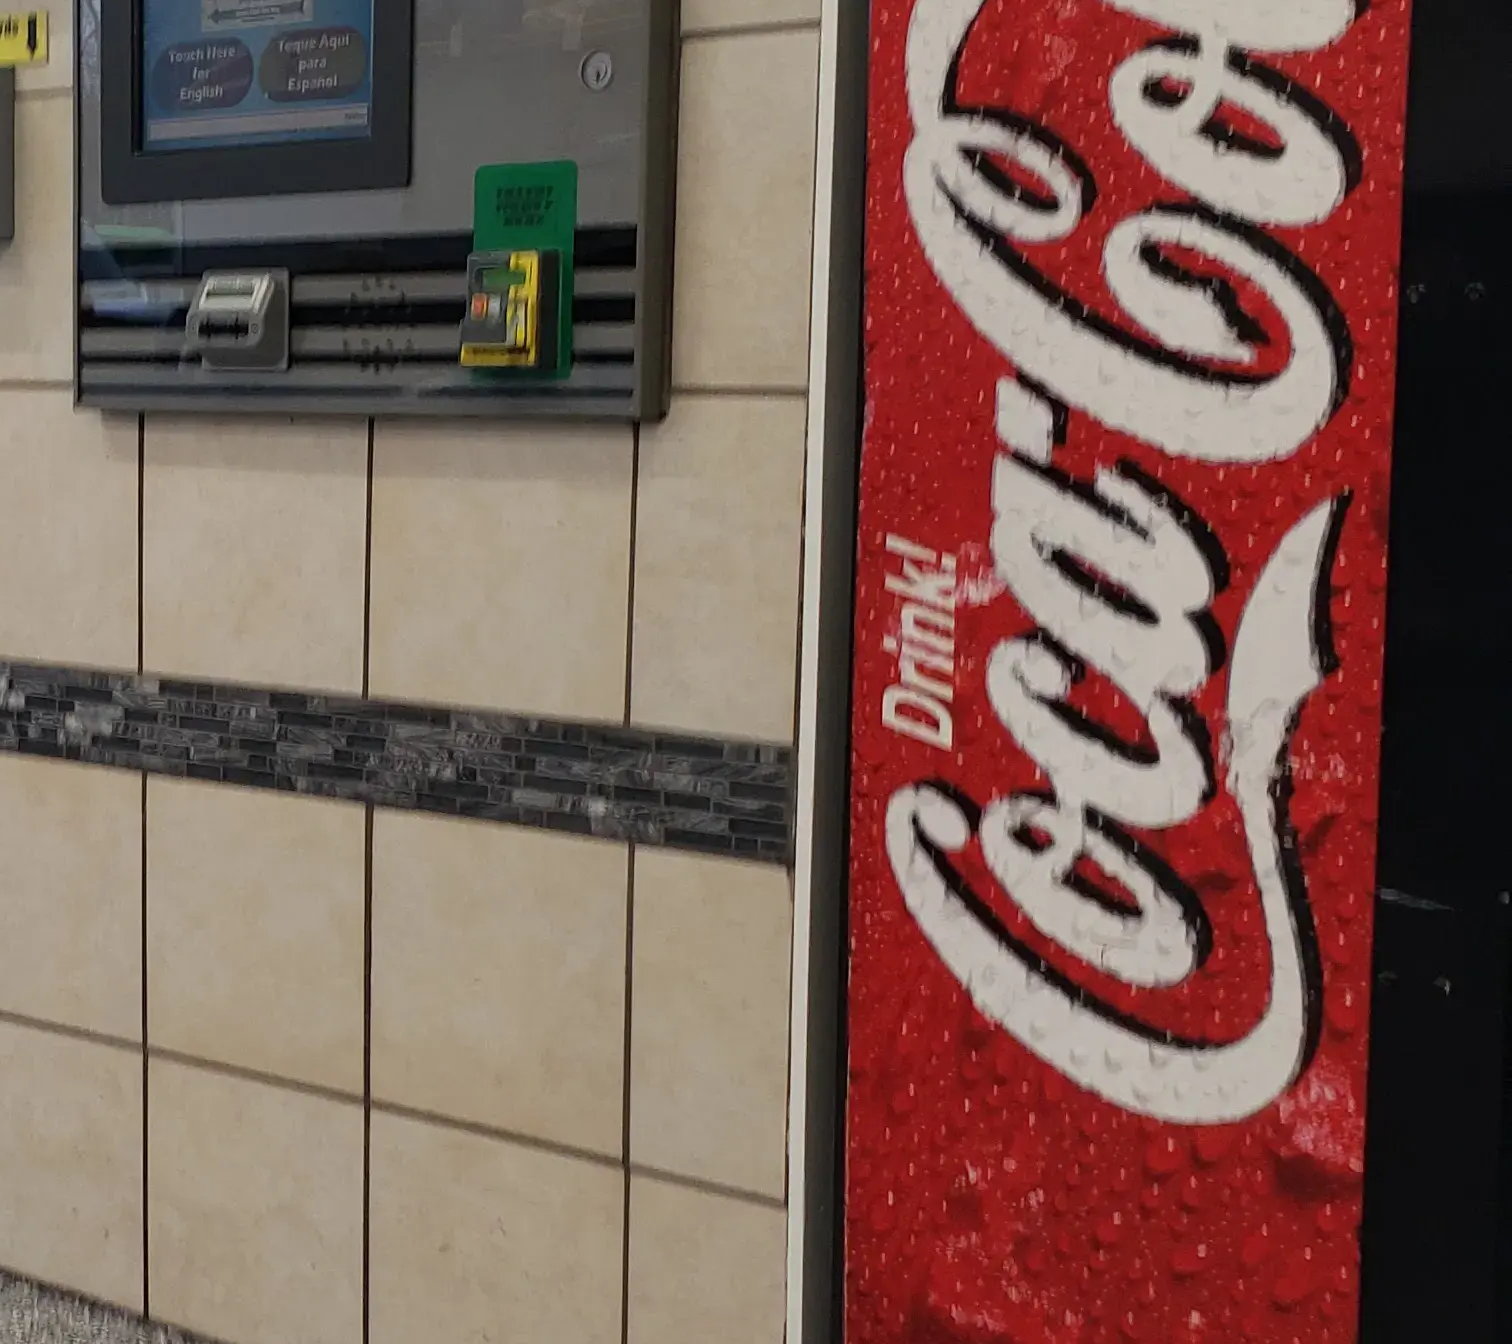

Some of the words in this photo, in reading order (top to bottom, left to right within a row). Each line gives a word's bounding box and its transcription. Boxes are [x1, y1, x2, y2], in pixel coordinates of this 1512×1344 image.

[168, 47, 205, 64] Touch
[298, 58, 327, 73] para
[179, 84, 225, 103] English
[882, 532, 955, 752] Drink!
